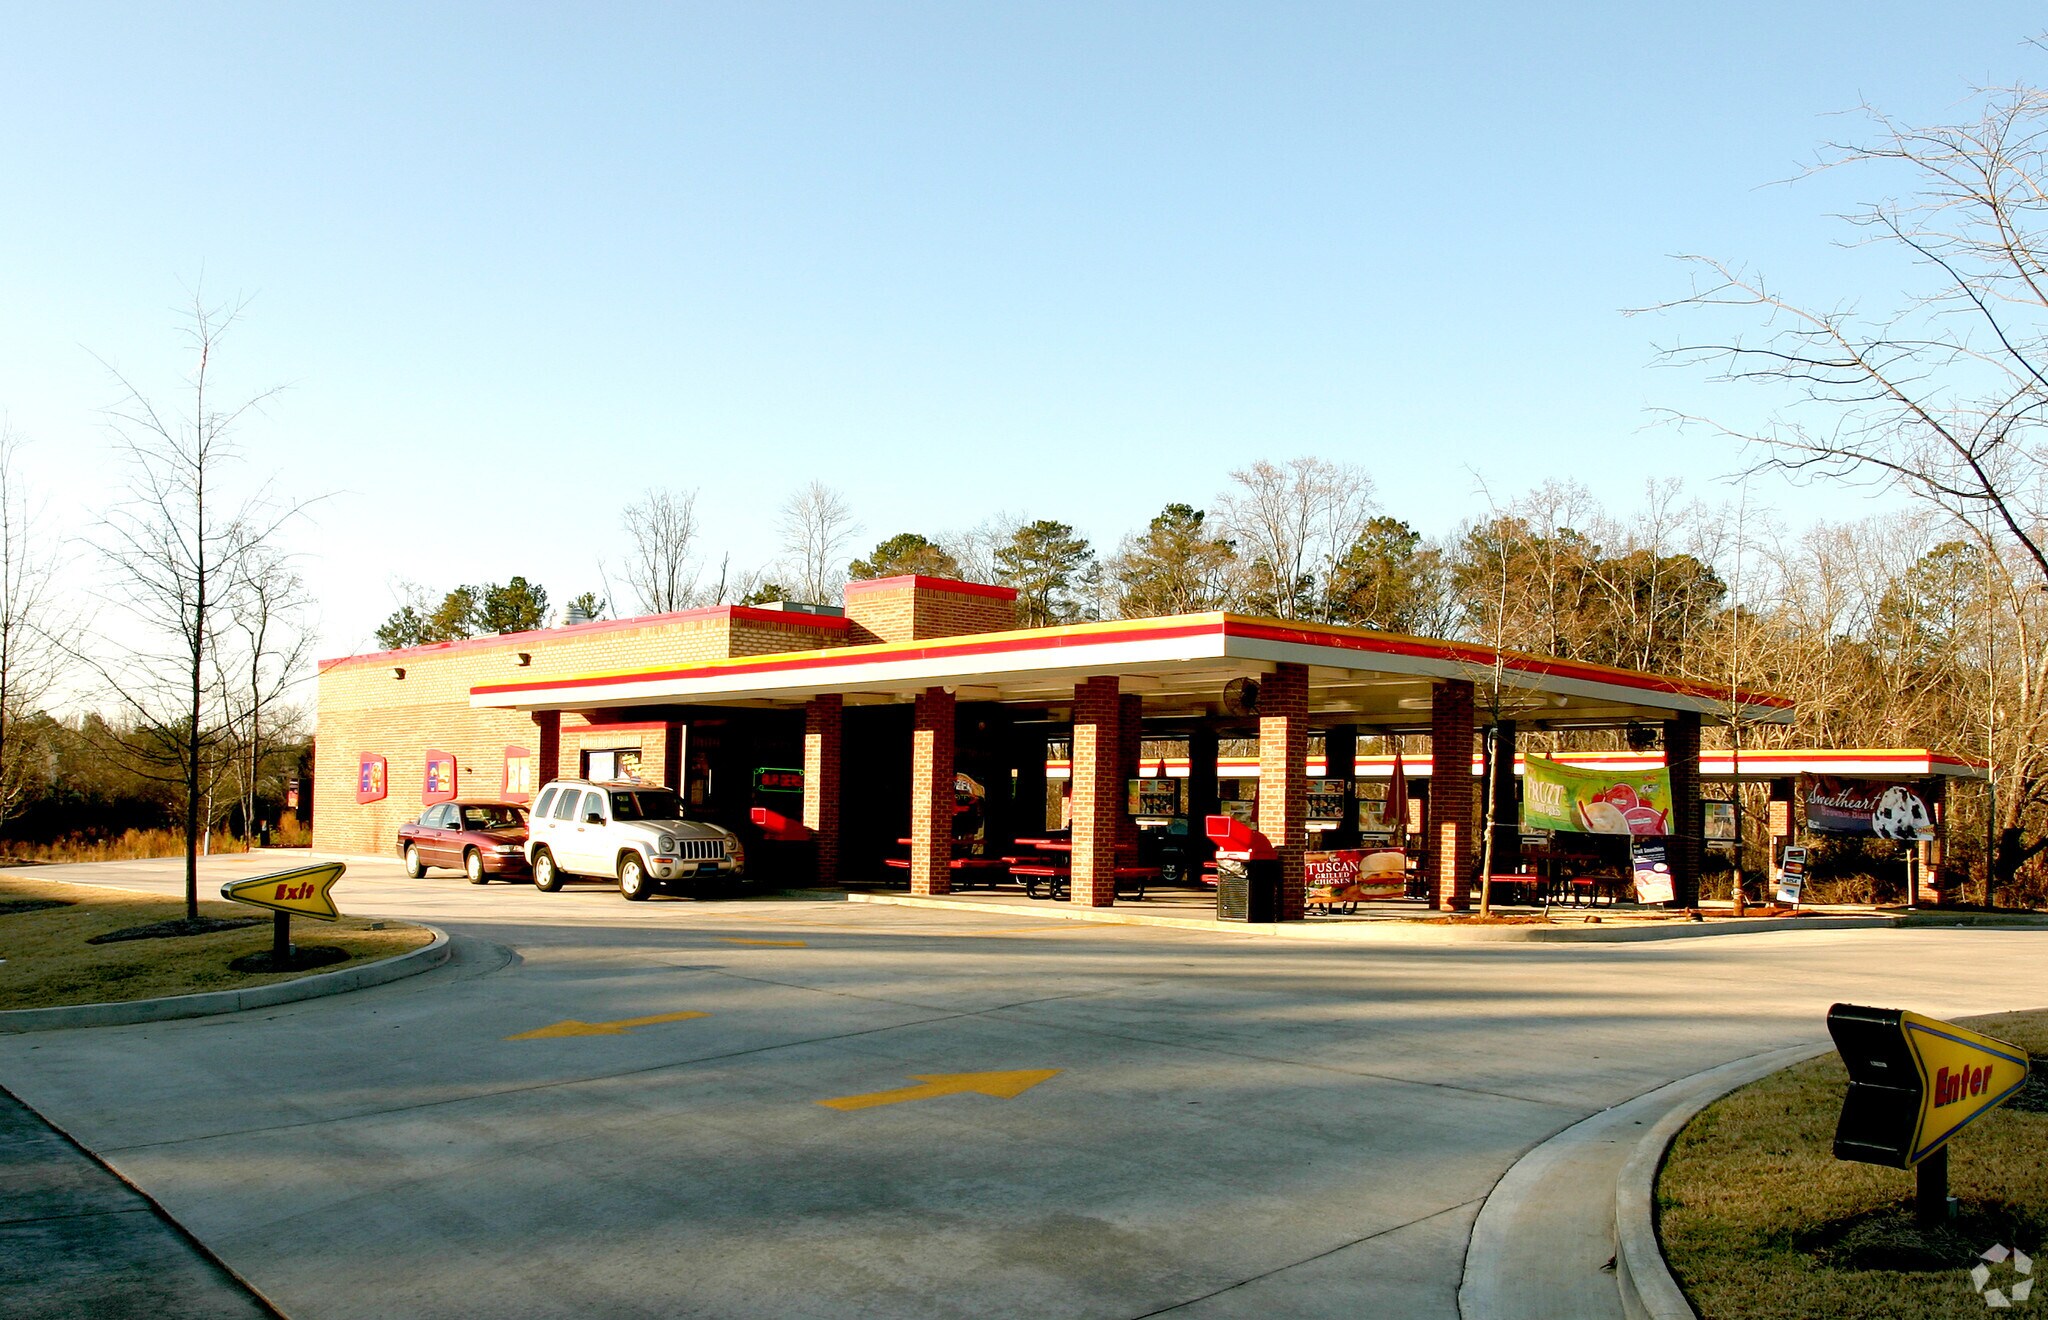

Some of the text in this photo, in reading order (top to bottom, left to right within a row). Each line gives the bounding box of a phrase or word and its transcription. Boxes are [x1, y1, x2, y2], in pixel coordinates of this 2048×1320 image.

[1806, 783, 1881, 810] Sweetheart
[1306, 860, 1359, 875] TUSCAN
[1315, 872, 1350, 880] GRILLED
[274, 881, 315, 900] Exit
[1934, 1064, 1993, 1109] Enter
